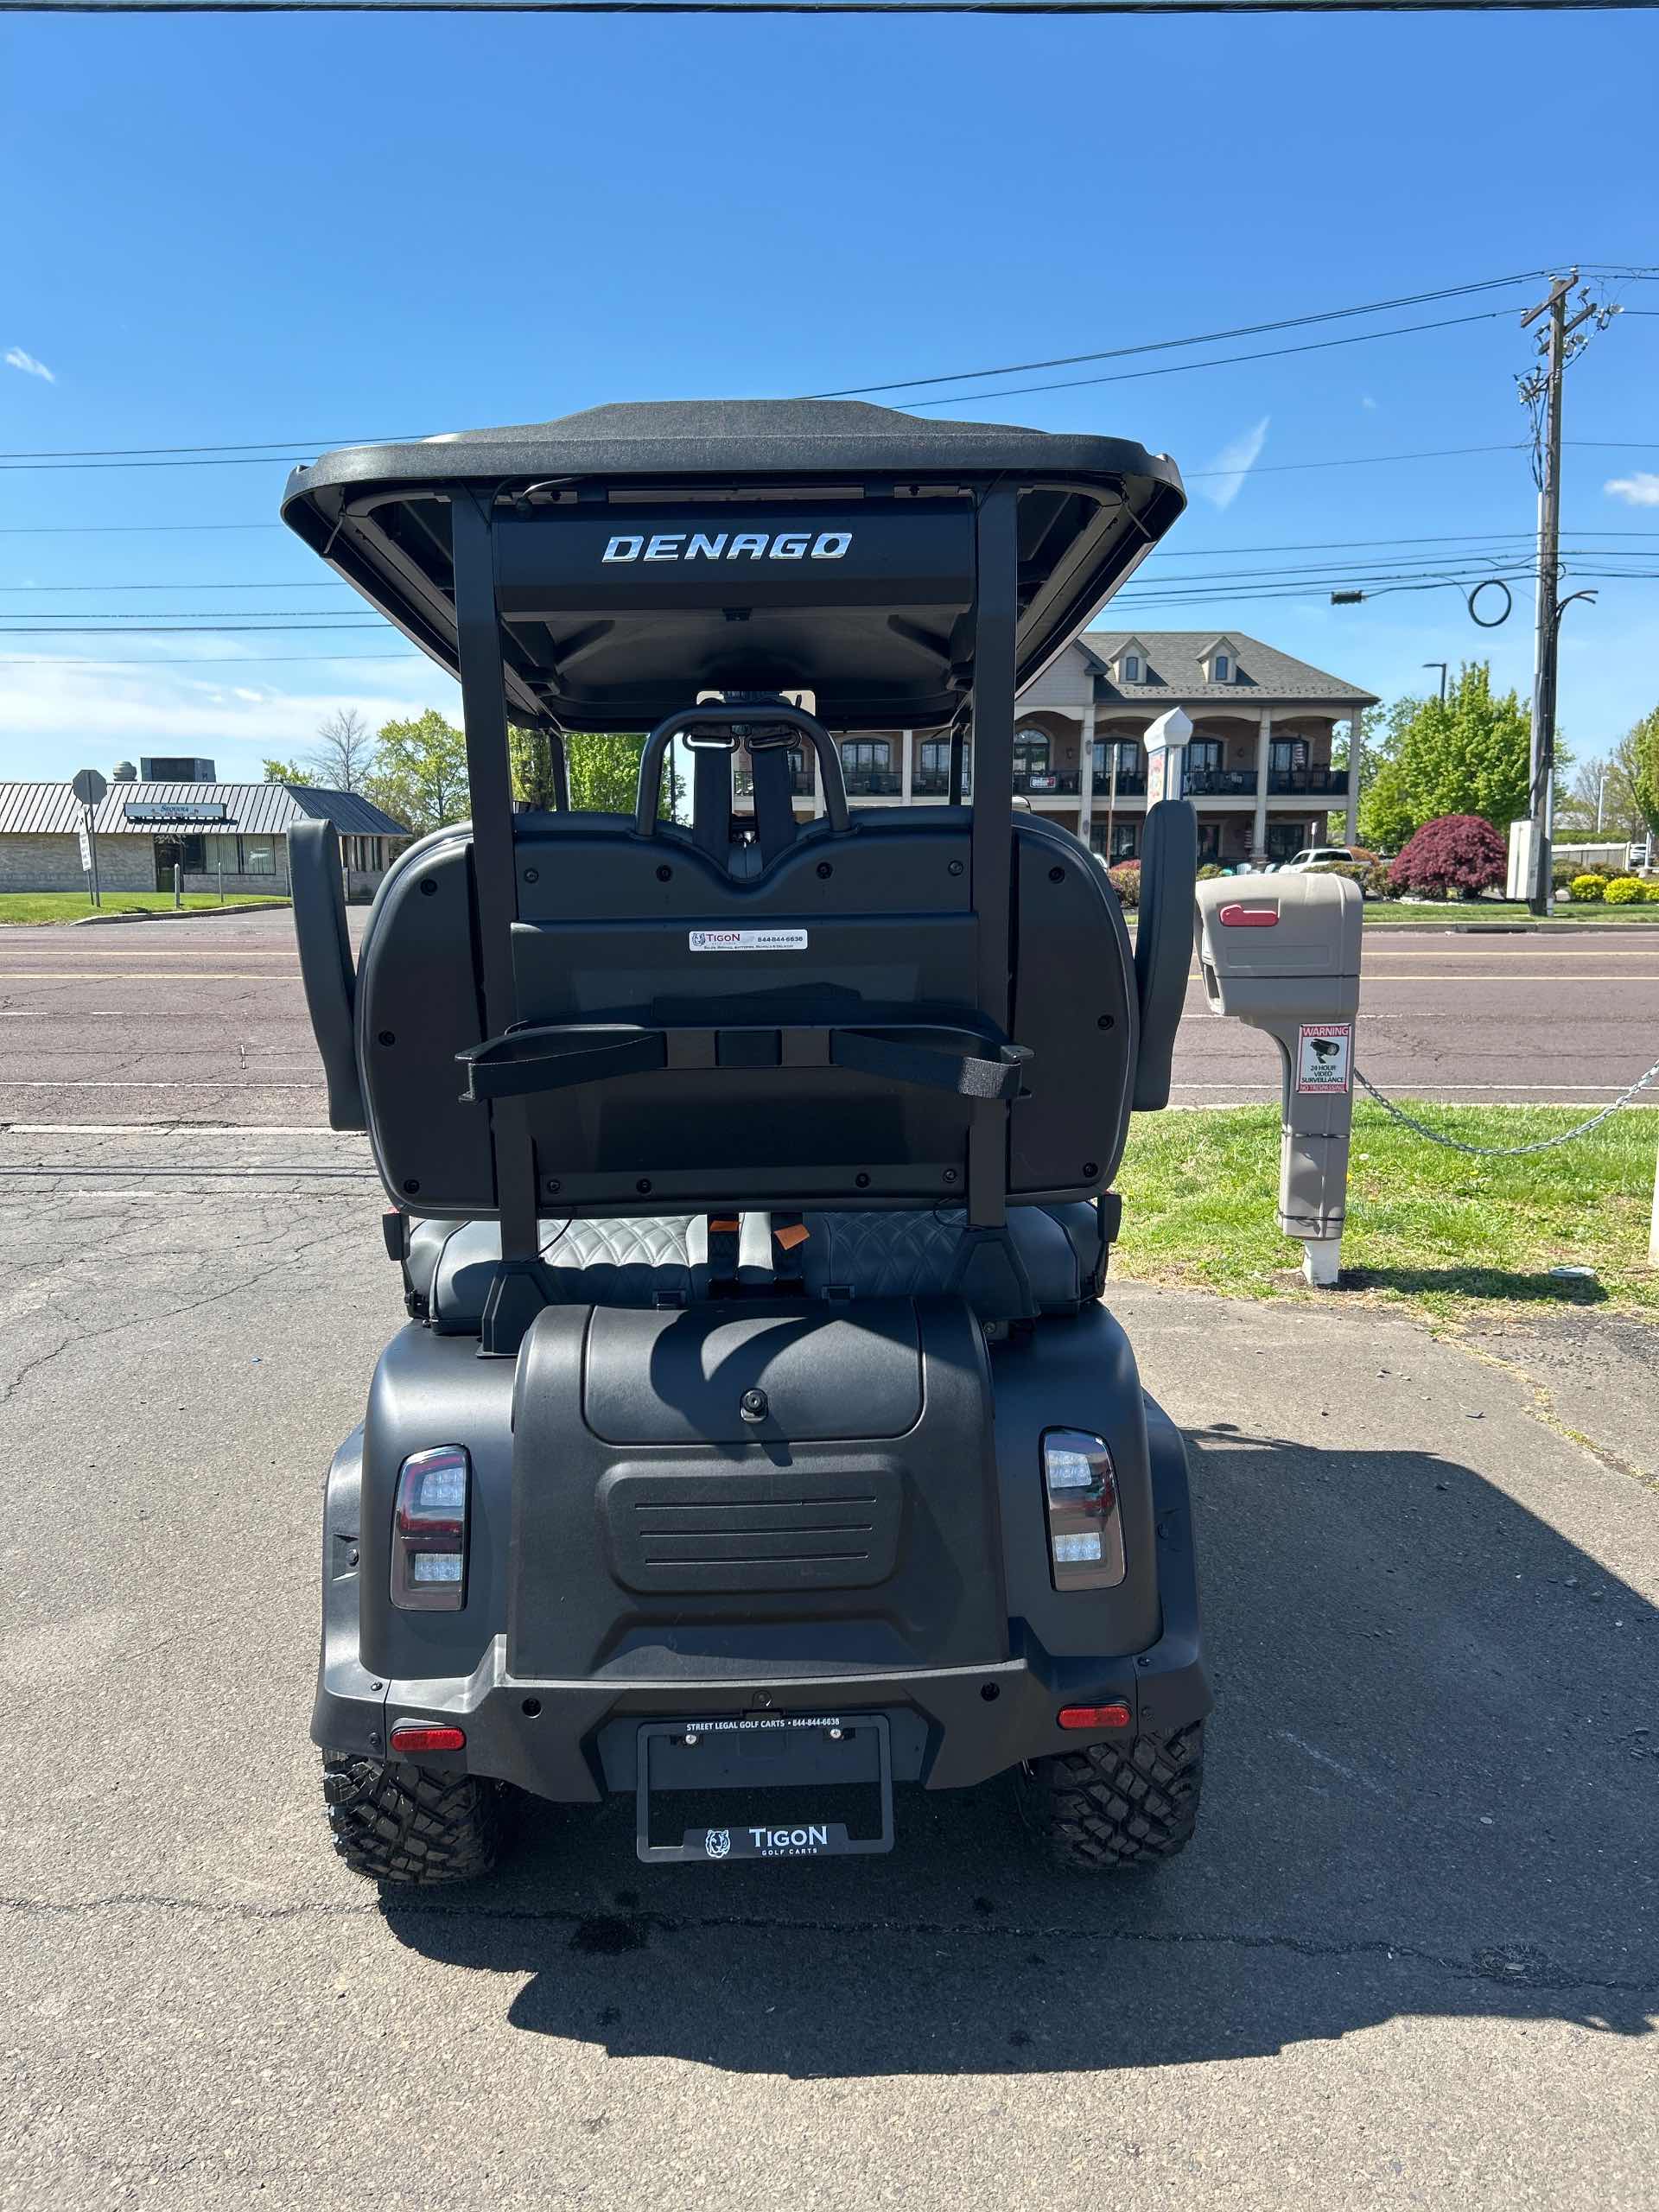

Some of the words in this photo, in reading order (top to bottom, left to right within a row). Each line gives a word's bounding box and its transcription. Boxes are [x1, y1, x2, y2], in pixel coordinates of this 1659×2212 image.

[601, 533, 853, 563] DENAGO
[1303, 1027, 1348, 1037] WARNING
[687, 1722, 714, 1731] STREET
[715, 1721, 738, 1730] LEGAL
[740, 1720, 760, 1729] GOLF
[760, 1719, 785, 1728] CARTS
[749, 1826, 827, 1847] TIGON
